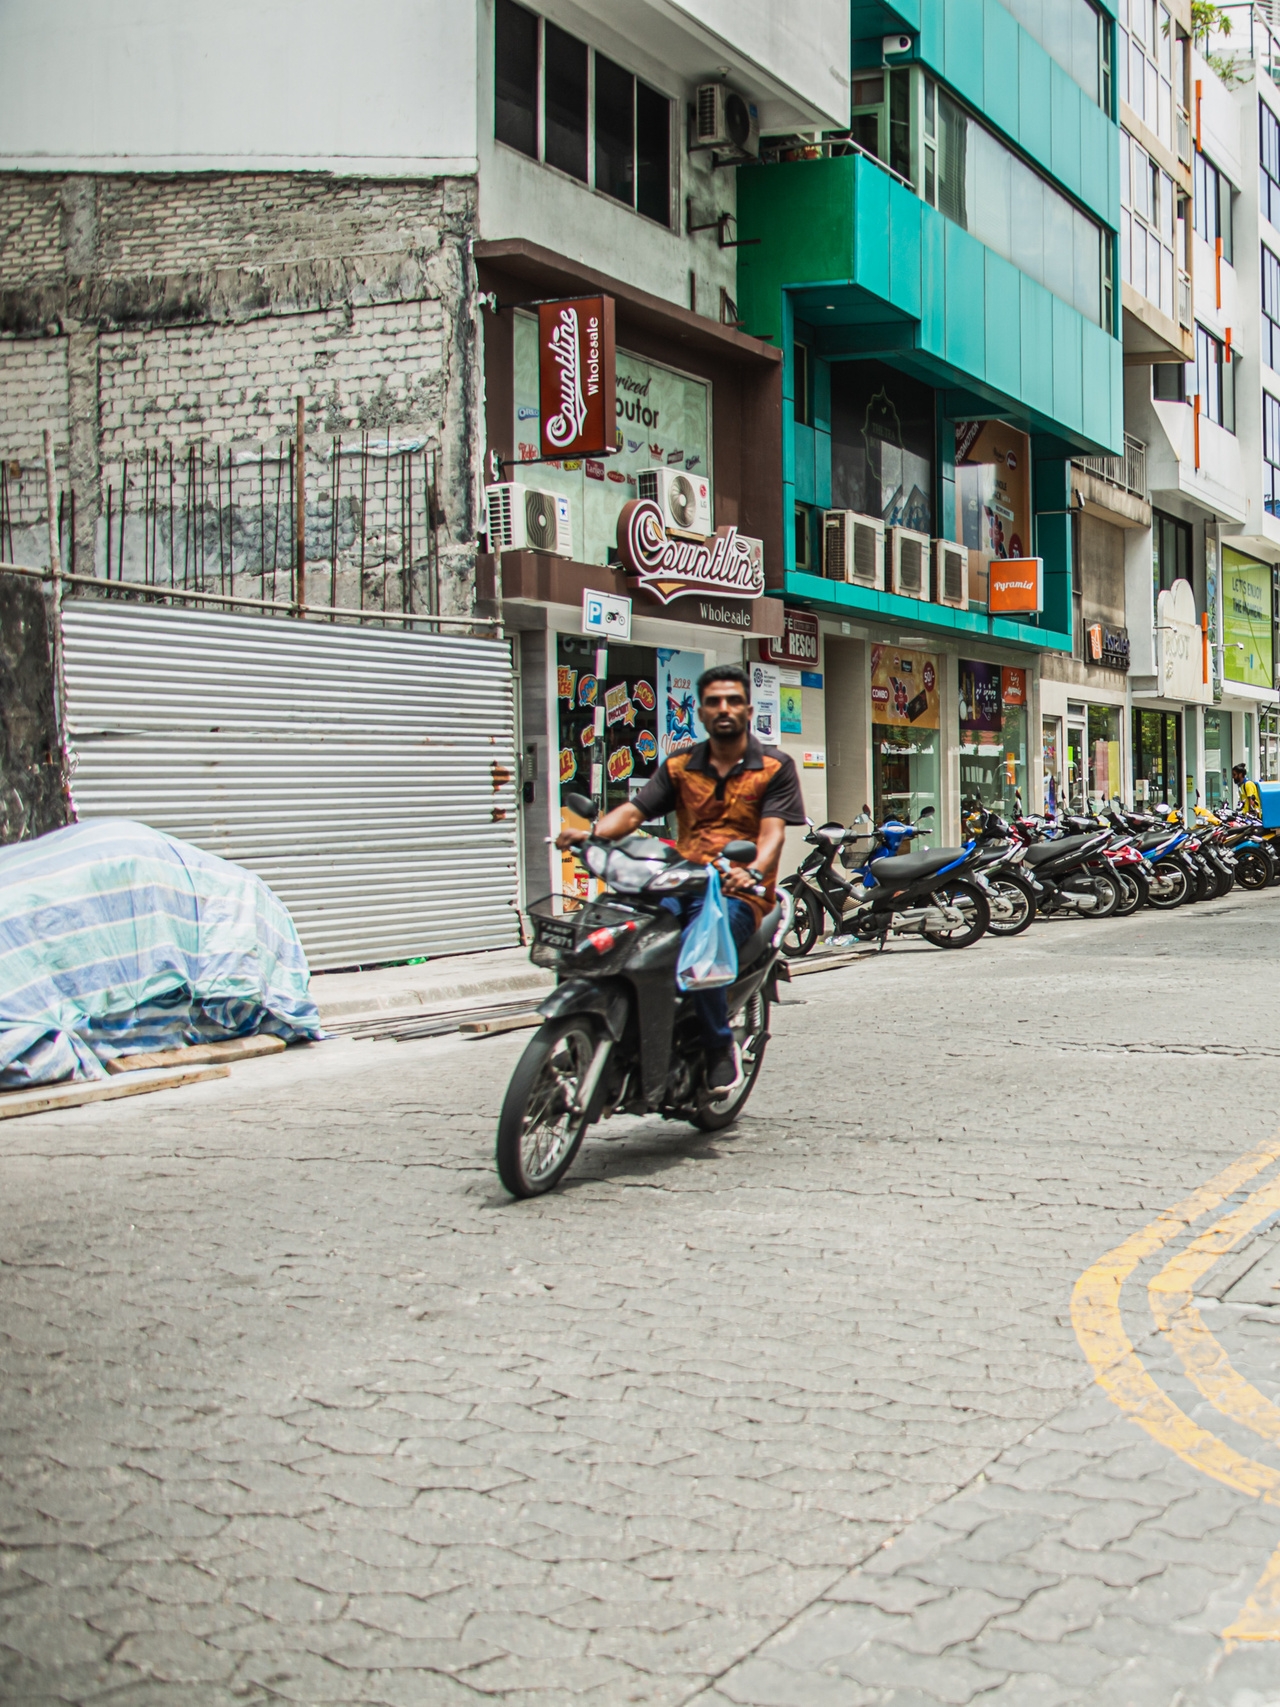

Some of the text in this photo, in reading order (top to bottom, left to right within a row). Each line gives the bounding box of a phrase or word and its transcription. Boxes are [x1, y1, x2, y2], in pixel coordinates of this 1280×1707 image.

[586, 316, 599, 397] Wholesale
[545, 306, 588, 448] Countline
[628, 500, 765, 604] Countline
[994, 580, 1034, 592] Pyramid
[590, 603, 600, 621] P
[700, 603, 751, 627] Wholesale
[673, 678, 691, 690] 2022
[872, 689, 888, 699] COMBO
[875, 702, 886, 711] PACK
